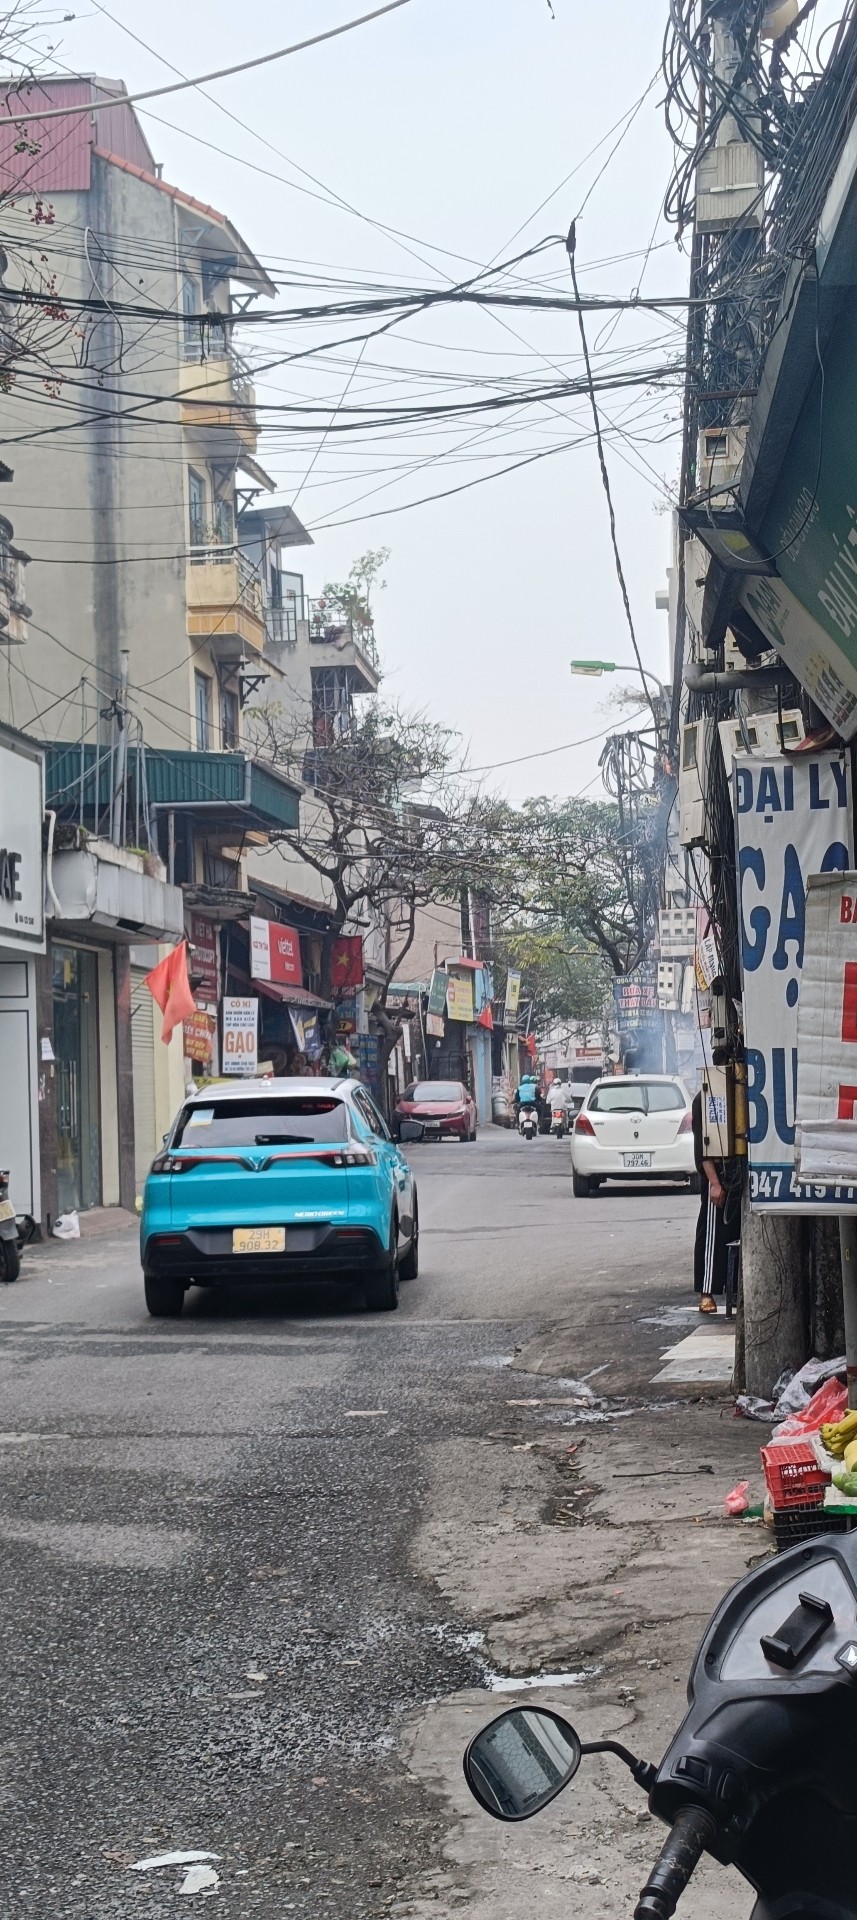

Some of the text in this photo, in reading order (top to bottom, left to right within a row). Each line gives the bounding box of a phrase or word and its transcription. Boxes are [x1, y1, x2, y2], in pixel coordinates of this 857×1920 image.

[736, 766, 794, 823] ĐẠI
[739, 842, 849, 1008] GẠ
[277, 937, 294, 957] Viettel
[642, 986, 655, 997] XE
[618, 997, 640, 1008] THAY
[249, 1230, 270, 1240] 29H
[239, 1240, 279, 1251] 908.32
